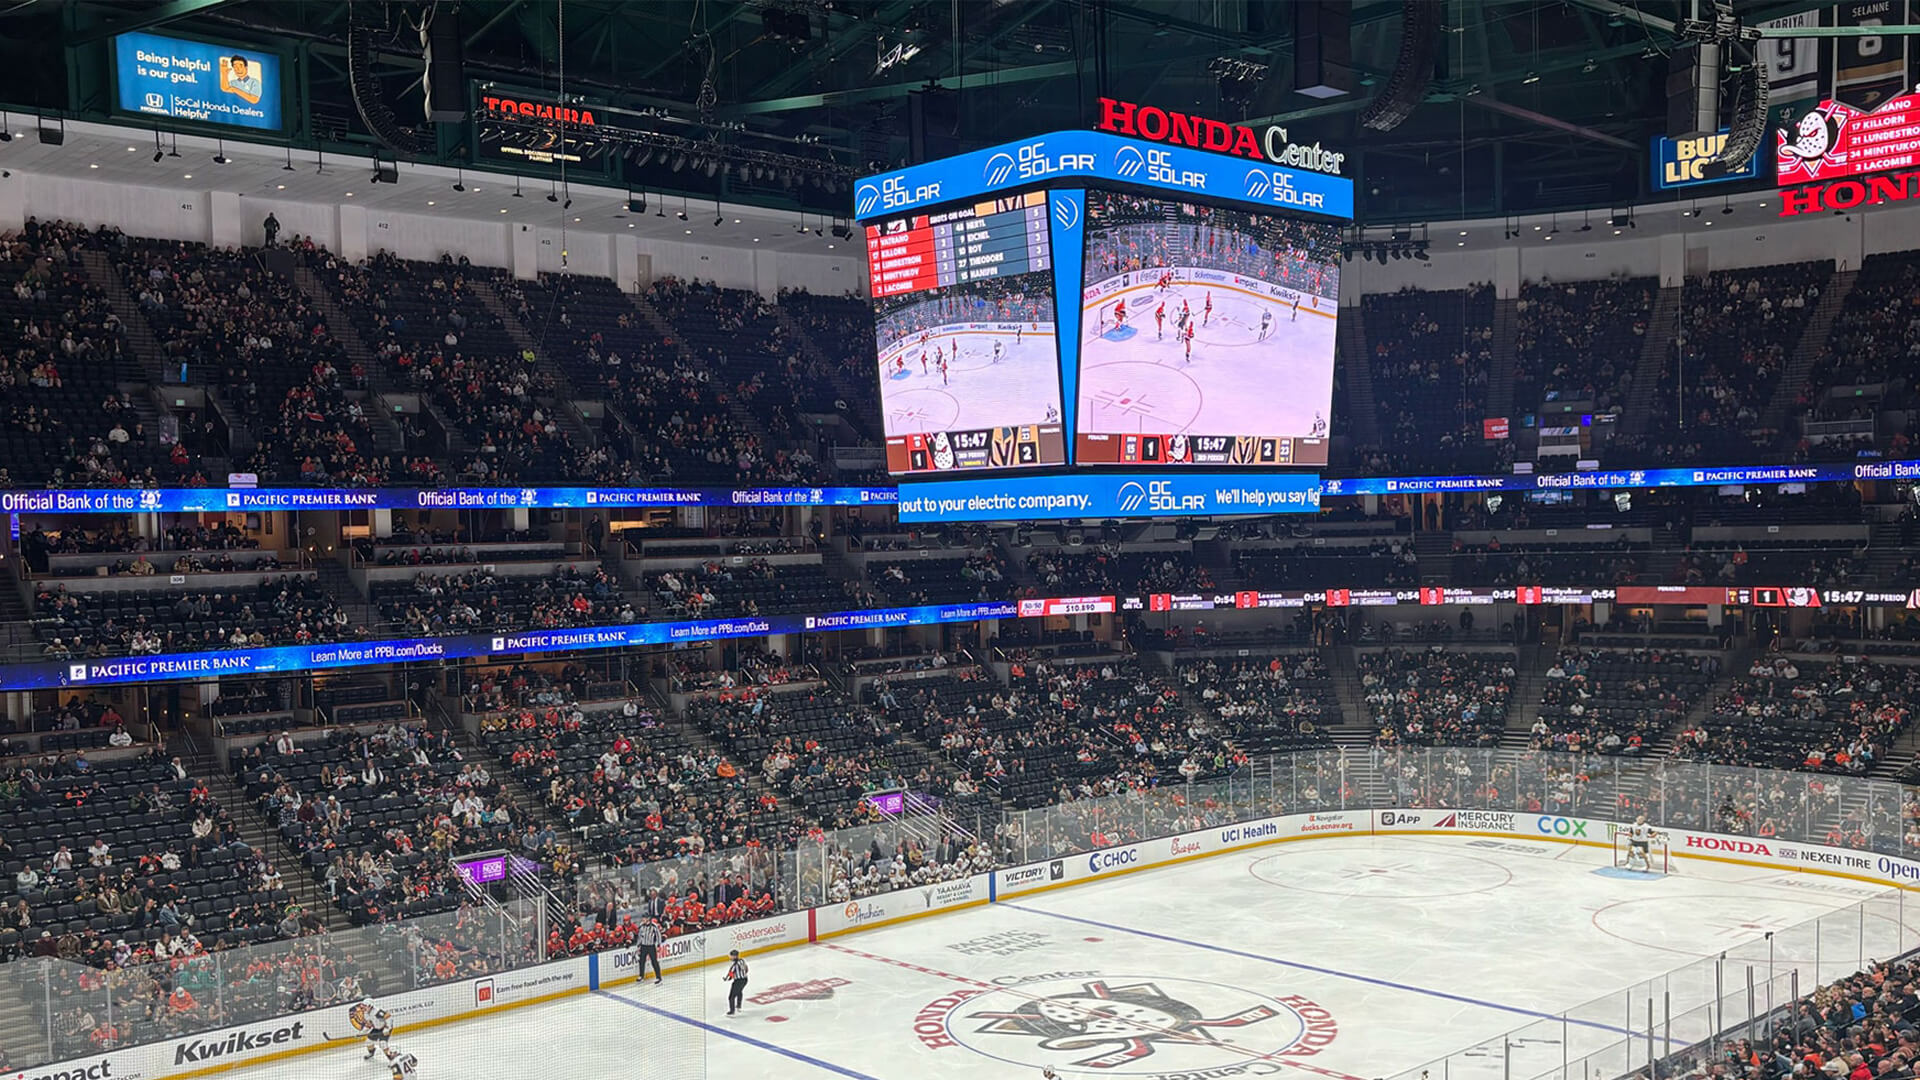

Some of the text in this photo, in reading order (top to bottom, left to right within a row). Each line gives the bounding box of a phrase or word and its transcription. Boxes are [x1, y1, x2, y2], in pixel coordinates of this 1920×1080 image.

[1852, 2, 1890, 17] SELANNE
[136, 50, 210, 72] Being helpful
[1777, 37, 1795, 72] 9
[137, 65, 198, 84] is our goal.
[175, 96, 264, 118] SoCal Honda Dealers
[483, 97, 595, 126] TOSHIBA
[1852, 115, 1905, 130] 17 KILLORN
[1098, 97, 1345, 174] HONDA Center
[1851, 136, 1861, 144] 21
[1019, 142, 1045, 162] OC
[1147, 148, 1171, 167] OC
[1019, 154, 1092, 179] SOLAR
[1856, 156, 1912, 170] 2 LACOMBE
[883, 175, 905, 193] OC
[1148, 167, 1206, 189] SOLAR
[1273, 172, 1293, 188] OC
[883, 183, 940, 209] SOLAR
[1273, 187, 1323, 208] SOLAR
[181, 203, 193, 211] 411
[959, 209, 974, 220] GOAL
[968, 244, 982, 253] ROY
[916, 433, 1032, 466] 1 15:47 2
[1127, 444, 1289, 456] 15 23
[1147, 438, 1272, 456] 1 15:47 2
[1706, 469, 1815, 480] PACIFIC PREMIER BANK
[1855, 464, 1892, 478] Official
[1150, 481, 1171, 496] OC
[1399, 479, 1502, 490] PACIFIC PREMIER BANK
[1537, 474, 1625, 487] Official Bank of the
[2, 493, 133, 511] Official Bank of the
[244, 494, 375, 505] PACIFIC PREMIER BANK
[418, 492, 516, 506] Official Bank of the
[599, 492, 700, 502] PACIFIC PREMIER BANK
[732, 490, 807, 504] Official Bank of the
[870, 491, 898, 501] PACIFIC
[902, 494, 1092, 515] out to your electric company.
[1150, 495, 1204, 510] SOLAR
[1216, 489, 1240, 504] We'll
[1242, 488, 1265, 507] help
[1267, 492, 1286, 507] you
[1288, 491, 1306, 506] say
[1214, 590, 1616, 604] 0:54 0:54 0:54 0:54 0:54
[1764, 592, 1770, 602] 1
[1823, 591, 1863, 603] 15:47
[1881, 594, 1905, 602] PERIOD
[817, 617, 848, 626] PACIFIC
[850, 615, 883, 624] PREMIER
[885, 614, 905, 623] BANK
[941, 610, 956, 618] Learn
[957, 609, 970, 617] More
[670, 622, 769, 638] Learn More at PPBI.com/Ducks
[507, 636, 548, 648] PACIFIC
[551, 634, 594, 646] PREMIER
[597, 632, 624, 643] BANK
[312, 644, 442, 663] Learn More at PPBI.com/Ducks
[91, 663, 146, 677] PACIFIC
[151, 659, 209, 673] PREMIER
[212, 657, 249, 670] BANK
[1397, 813, 1420, 824] App
[1457, 820, 1515, 831] INSURANCE
[1458, 812, 1514, 823] MERCURY
[1222, 822, 1276, 843] UCI Health
[1537, 816, 1588, 838] COX
[1686, 835, 1773, 856] HONDA
[1104, 849, 1137, 867] CHOC
[1801, 850, 1842, 866] NEXEN
[1844, 856, 1872, 870] TIRE
[1005, 867, 1044, 882] VICTORY
[855, 904, 884, 923] Anaheim
[736, 923, 786, 941] easterseals
[946, 930, 1026, 950] PACIFIC
[958, 933, 1050, 955] PREMIER
[992, 941, 1052, 956] BANK
[496, 973, 573, 993] Earn free food with the app
[991, 970, 1100, 986] Center
[914, 989, 984, 1050] HONDA
[1275, 994, 1338, 1056] HONDA
[174, 1021, 303, 1066] Kwikset
